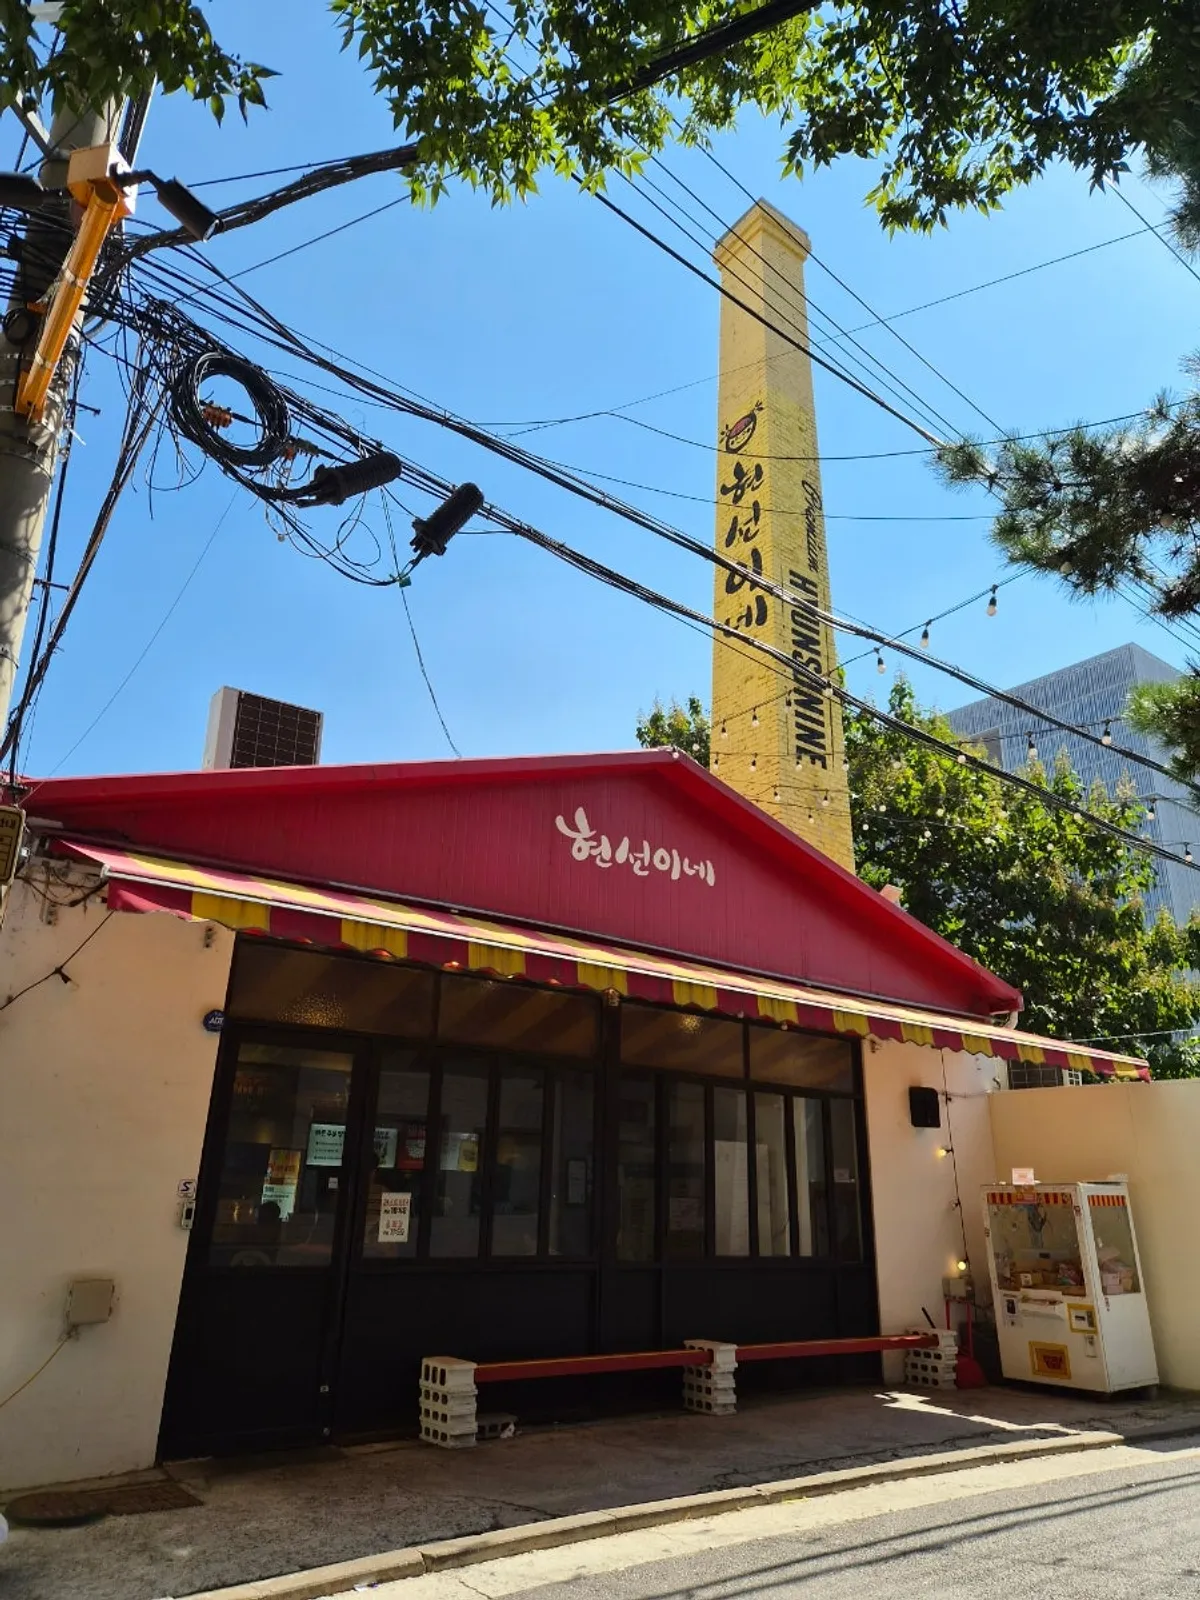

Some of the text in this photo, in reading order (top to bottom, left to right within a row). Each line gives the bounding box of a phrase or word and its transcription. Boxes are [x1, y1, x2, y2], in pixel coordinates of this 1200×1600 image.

[720, 461, 768, 638] 현선이네
[802, 480, 822, 573] Premium
[555, 807, 715, 886] 현선이네
